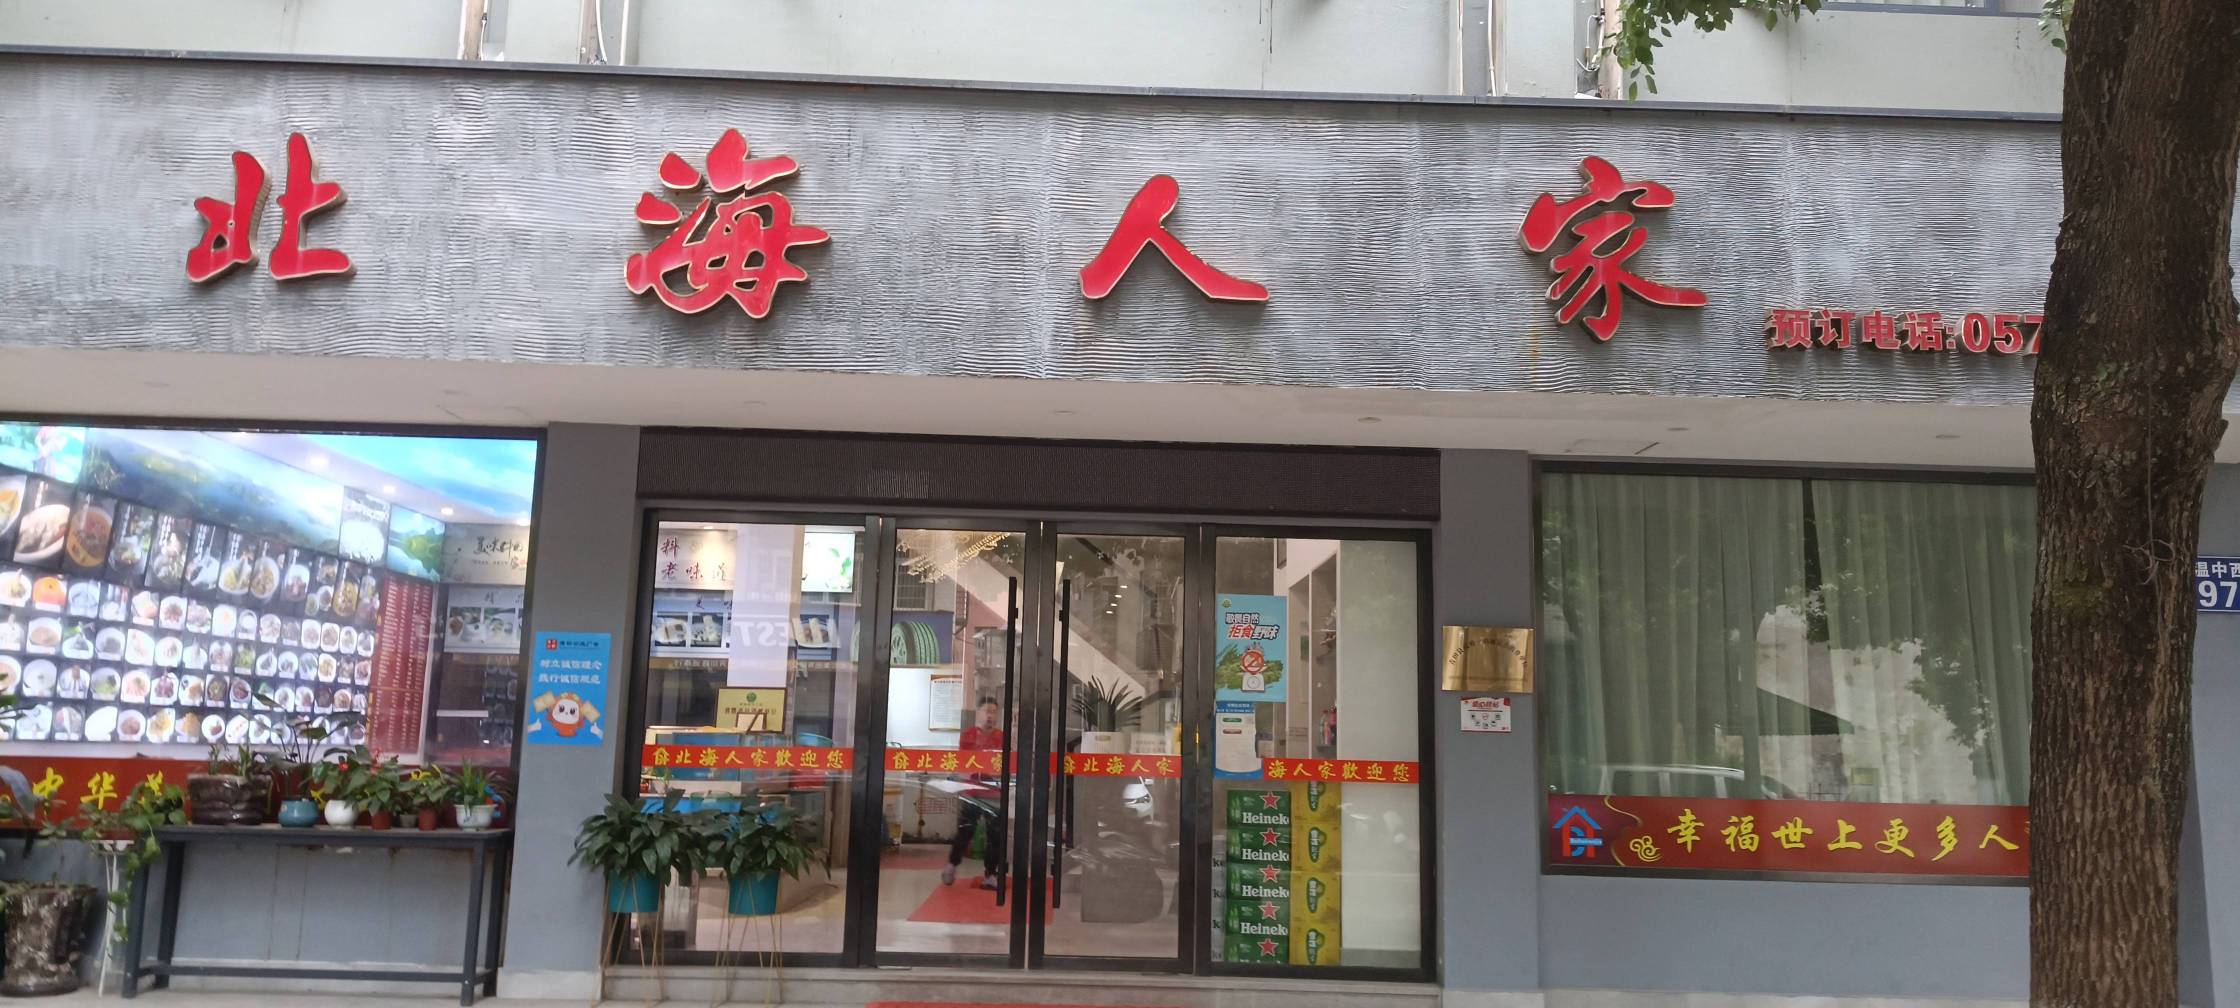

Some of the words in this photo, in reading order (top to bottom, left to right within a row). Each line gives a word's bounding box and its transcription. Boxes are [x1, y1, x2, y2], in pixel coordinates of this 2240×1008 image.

[186, 128, 1708, 342] 北海人家
[2198, 580, 2238, 608] 97
[1228, 625, 1279, 640] 拒食野味
[1667, 809, 2030, 862] 幸福世上更多人
